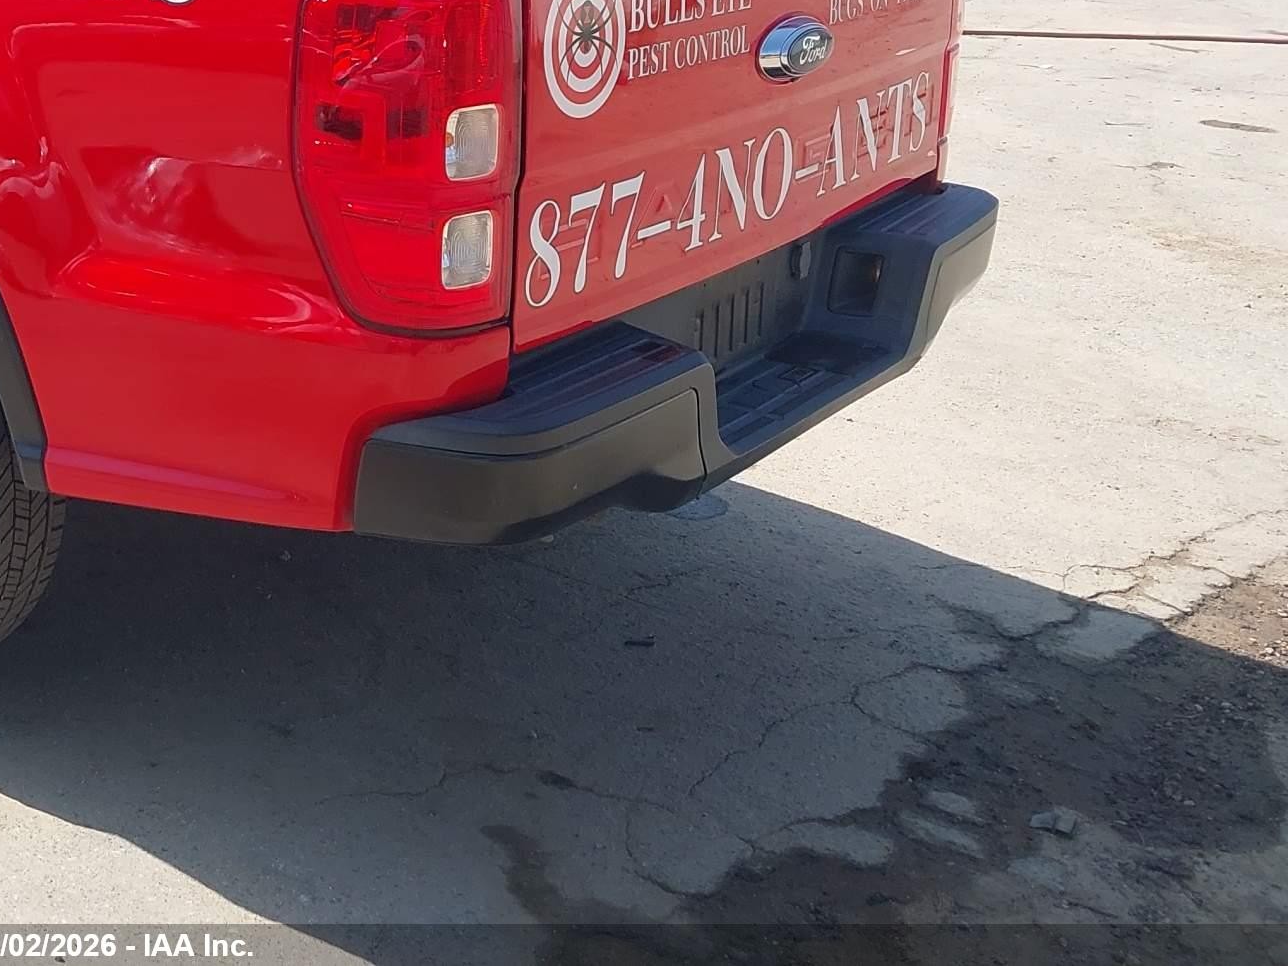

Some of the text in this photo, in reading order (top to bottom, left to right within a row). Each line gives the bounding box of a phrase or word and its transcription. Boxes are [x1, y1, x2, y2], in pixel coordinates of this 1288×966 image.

[627, 25, 750, 81] PEST CONTROL
[799, 35, 827, 65] Ford
[524, 71, 932, 308] 877-4NO-ANTS
